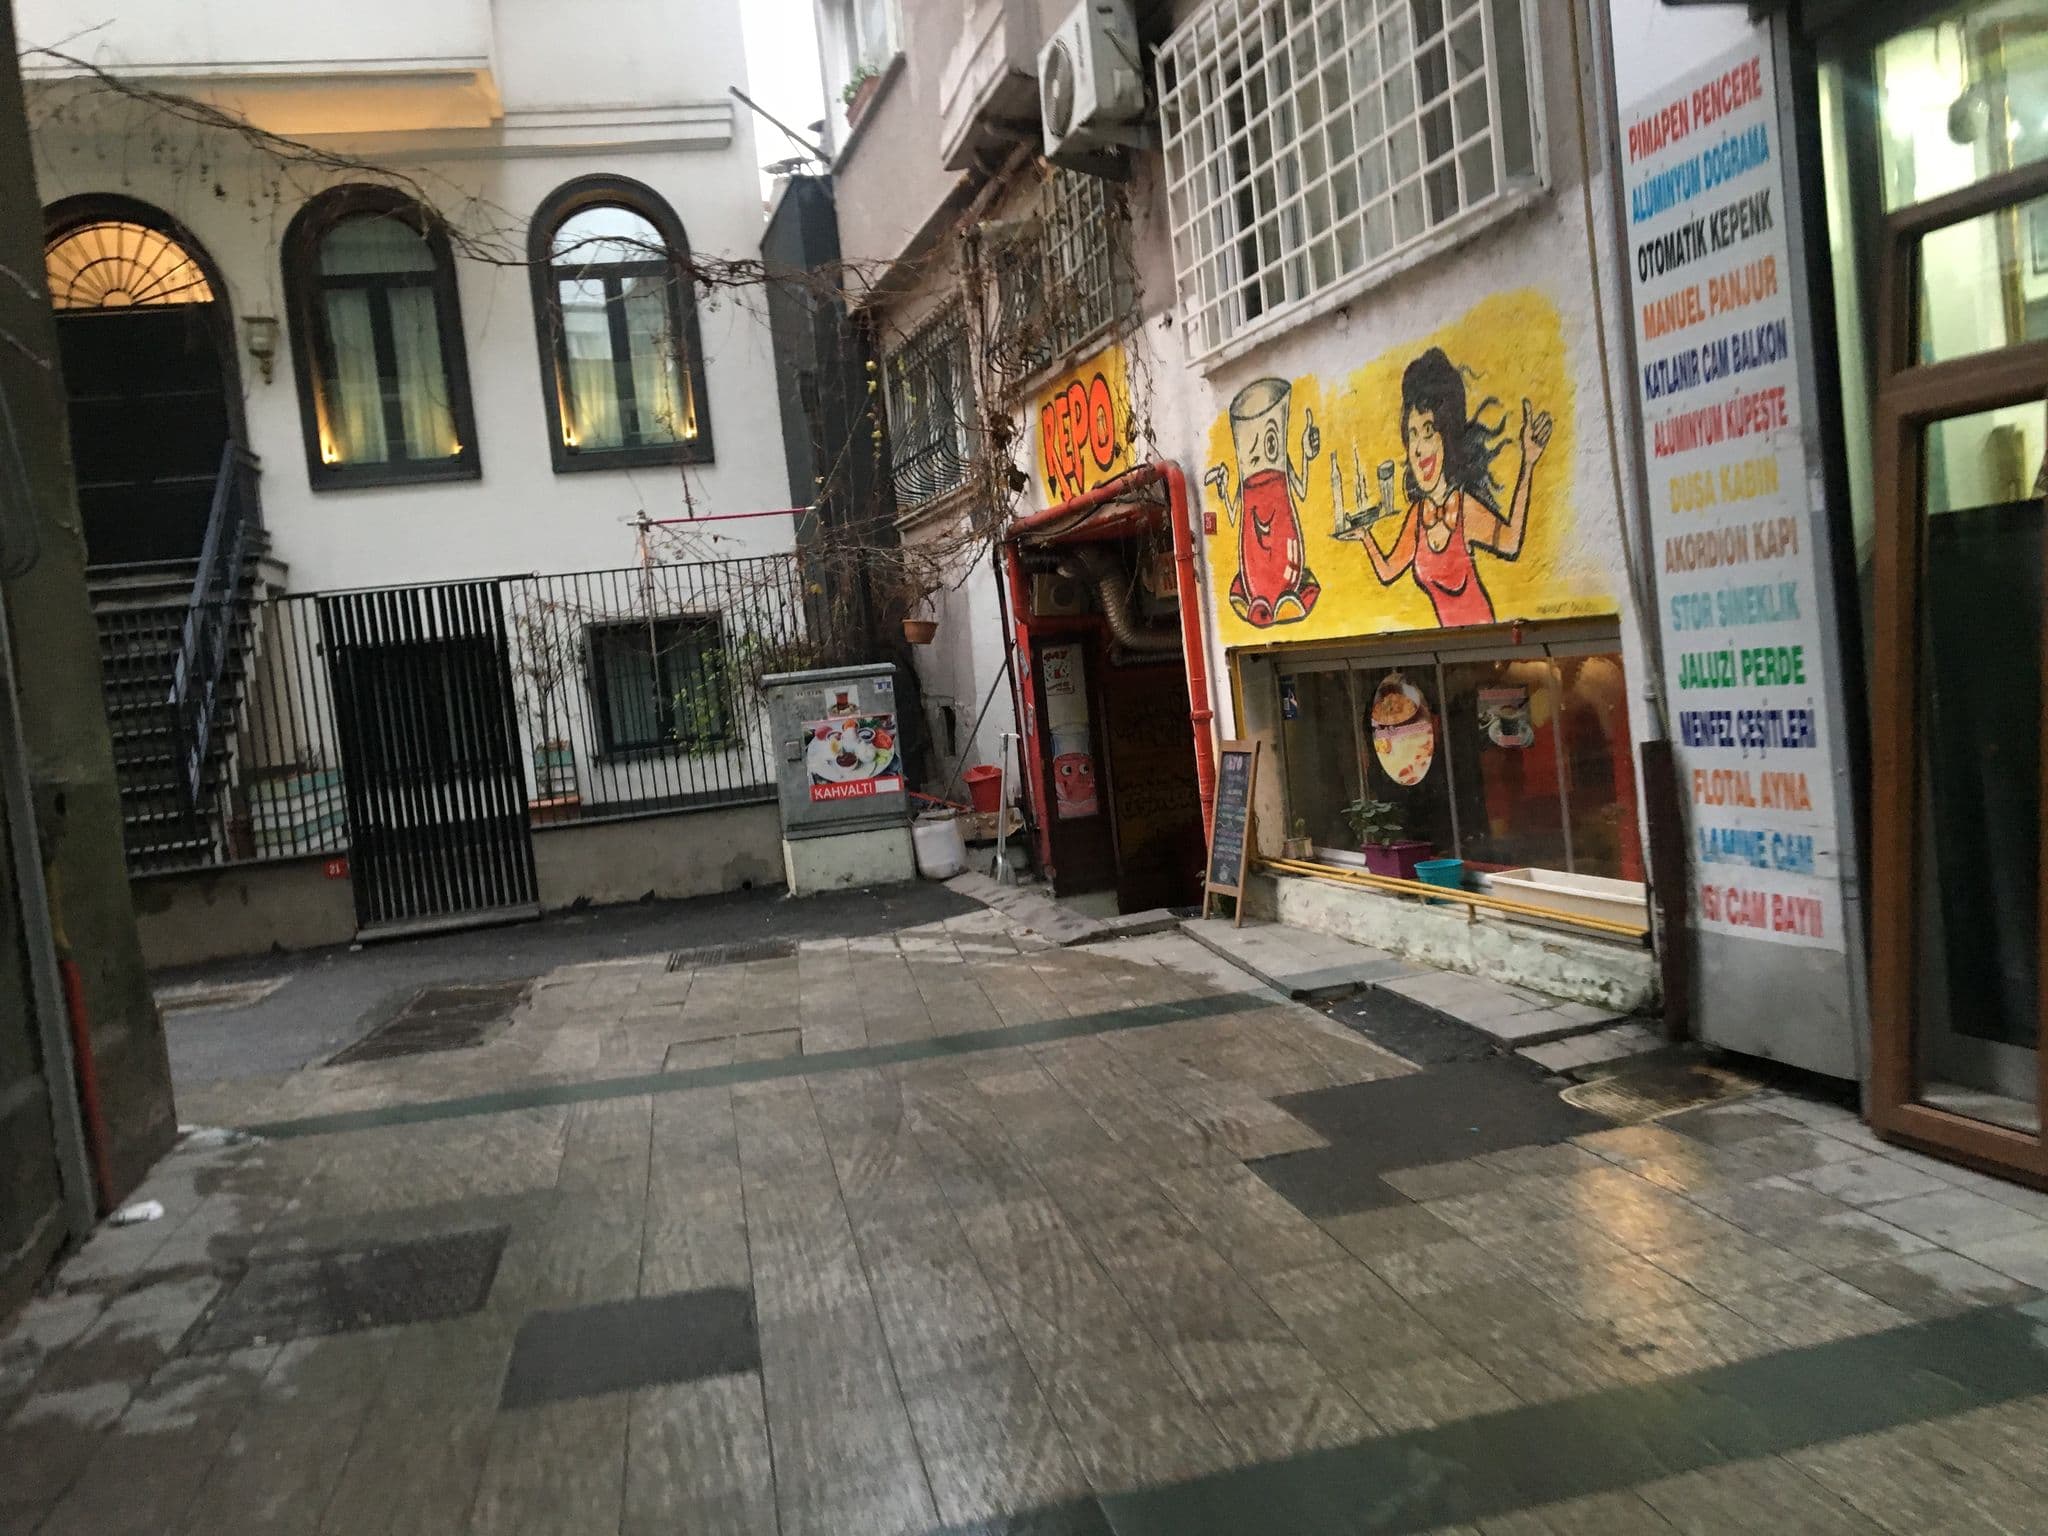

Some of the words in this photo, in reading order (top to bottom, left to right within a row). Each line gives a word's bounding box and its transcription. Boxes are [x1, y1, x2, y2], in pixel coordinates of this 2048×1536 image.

[1692, 55, 1763, 131] PENCERE
[1637, 209, 1708, 284] OTOMATİK
[1709, 188, 1773, 251] KEPENK
[1643, 285, 1705, 342] MANUEL
[1708, 254, 1778, 317] PANJUR
[1644, 346, 1701, 401] KATLANIR
[1702, 335, 1730, 384] CAM
[1731, 315, 1788, 374] BALKON
[1041, 371, 1115, 503] REPO
[1751, 514, 1800, 562] KAPI
[1670, 590, 1715, 632] STOR
[1740, 644, 1807, 687] PERDE
[814, 781, 873, 800] KAHVALTI
[1692, 768, 1756, 808] FLOTAL
[1760, 771, 1813, 812] AYNA
[1772, 831, 1815, 875] CAM
[1725, 886, 1768, 930] CAM
